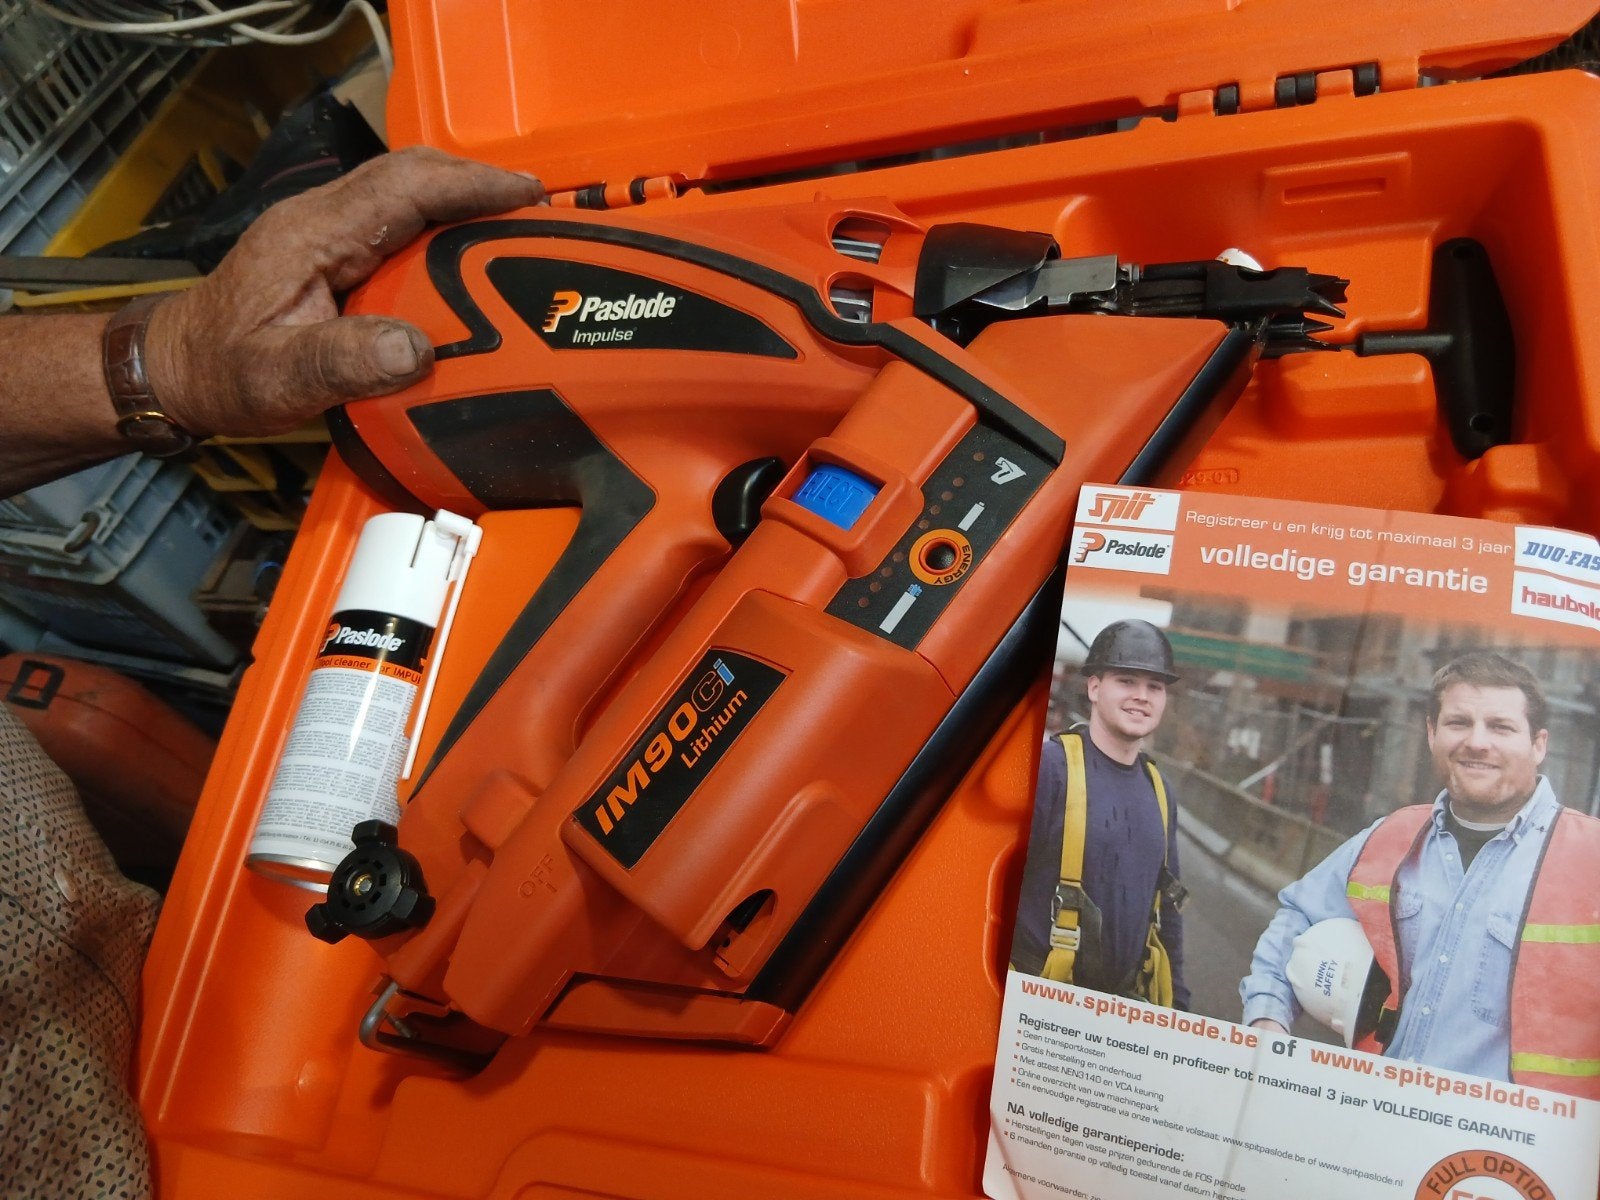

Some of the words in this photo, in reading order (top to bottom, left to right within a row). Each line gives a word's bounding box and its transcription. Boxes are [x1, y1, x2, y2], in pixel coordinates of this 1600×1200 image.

[579, 292, 676, 322] Paslode
[572, 328, 634, 346] Impulse
[1105, 540, 1166, 559] Paslode
[1185, 510, 1268, 529] Registreer
[1272, 521, 1282, 531] u
[1287, 523, 1306, 534] en
[1311, 522, 1344, 540] krijg
[1349, 527, 1373, 540] tot
[1377, 530, 1456, 549] maximaal
[1461, 537, 1474, 550] 3
[1478, 539, 1512, 555] jaar
[934, 544, 971, 585] ENERGY
[1200, 543, 1336, 581] volledige
[1348, 560, 1488, 593] garantie
[335, 626, 402, 652] Paslode
[333, 657, 371, 668] cleaner
[595, 658, 735, 836] IM90Ci
[680, 689, 749, 769] Lithium
[518, 853, 554, 897] OFF
[1315, 960, 1328, 989] THINK
[1323, 959, 1338, 997] SAFETY
[1021, 979, 1258, 1048] www.spitpaslode.be
[1271, 1039, 1297, 1057] of
[1310, 1048, 1577, 1119] www.spitpaslode.nl
[1021, 1042, 1044, 1055] Gratis
[1045, 1048, 1085, 1068] herstelling
[1087, 1061, 1097, 1070] en
[1099, 1063, 1142, 1081] onderhoud
[1022, 1029, 1043, 1042] Geen
[1044, 1036, 1106, 1058] transportkosten
[1018, 1067, 1041, 1081] Online
[1042, 1076, 1077, 1091] overzicht
[1078, 1086, 1092, 1095] van
[1093, 1090, 1105, 1098] uw
[1107, 1092, 1159, 1113] machinepark
[1019, 1054, 1035, 1066] Met
[1036, 1059, 1059, 1073] attest
[1061, 1066, 1102, 1084] NEN3140
[1103, 1079, 1113, 1087] en
[1115, 1080, 1133, 1093] VCA
[1134, 1086, 1164, 1103] keuring
[1019, 1012, 1081, 1038] Registreer
[1085, 1032, 1102, 1044] uw
[1106, 1036, 1149, 1056] toestel
[1153, 1049, 1168, 1061] en
[1172, 1054, 1230, 1075] profiteer
[1234, 1067, 1253, 1081] tot
[1257, 1073, 1322, 1098] maximaal
[1326, 1088, 1336, 1101] 3
[1340, 1091, 1368, 1108] jaar
[1372, 1098, 1453, 1128] VOLLEDIGE
[1457, 1117, 1536, 1146] GARANTIE
[1007, 1101, 1025, 1117] NA
[1029, 1110, 1079, 1133] volledige
[1082, 1126, 1185, 1162] garantieperiode:
[1016, 1078, 1031, 1090] Een
[1032, 1085, 1074, 1103] eenvoudige
[1076, 1096, 1117, 1114] registratie
[1118, 1108, 1130, 1117] via
[1131, 1112, 1151, 1123] onze
[1152, 1117, 1184, 1132] website
[1222, 1135, 1306, 1163] www.spitpaslode.be
[1307, 1157, 1318, 1166] of
[1318, 1161, 1403, 1187] www.spitpaslode.nl
[1009, 1131, 1016, 1140] 6
[1017, 1135, 1052, 1151] maanden
[1053, 1146, 1086, 1162] garantie
[1087, 1157, 1098, 1165] op
[1099, 1160, 1128, 1176] volledig
[1129, 1168, 1158, 1182] toestel
[1159, 1177, 1182, 1189] vanaf
[1183, 1183, 1211, 1197] datum
[1011, 1119, 1061, 1140] Herstellingen
[1062, 1134, 1084, 1147] tegen
[1085, 1143, 1107, 1154] vaste
[1108, 1149, 1135, 1162] prijzen
[1136, 1156, 1181, 1175] gedurende
[1182, 1169, 1193, 1178] de
[1194, 1171, 1213, 1184] FOS
[1213, 1178, 1246, 1193] periode
[1426, 1157, 1476, 1195] FULL
